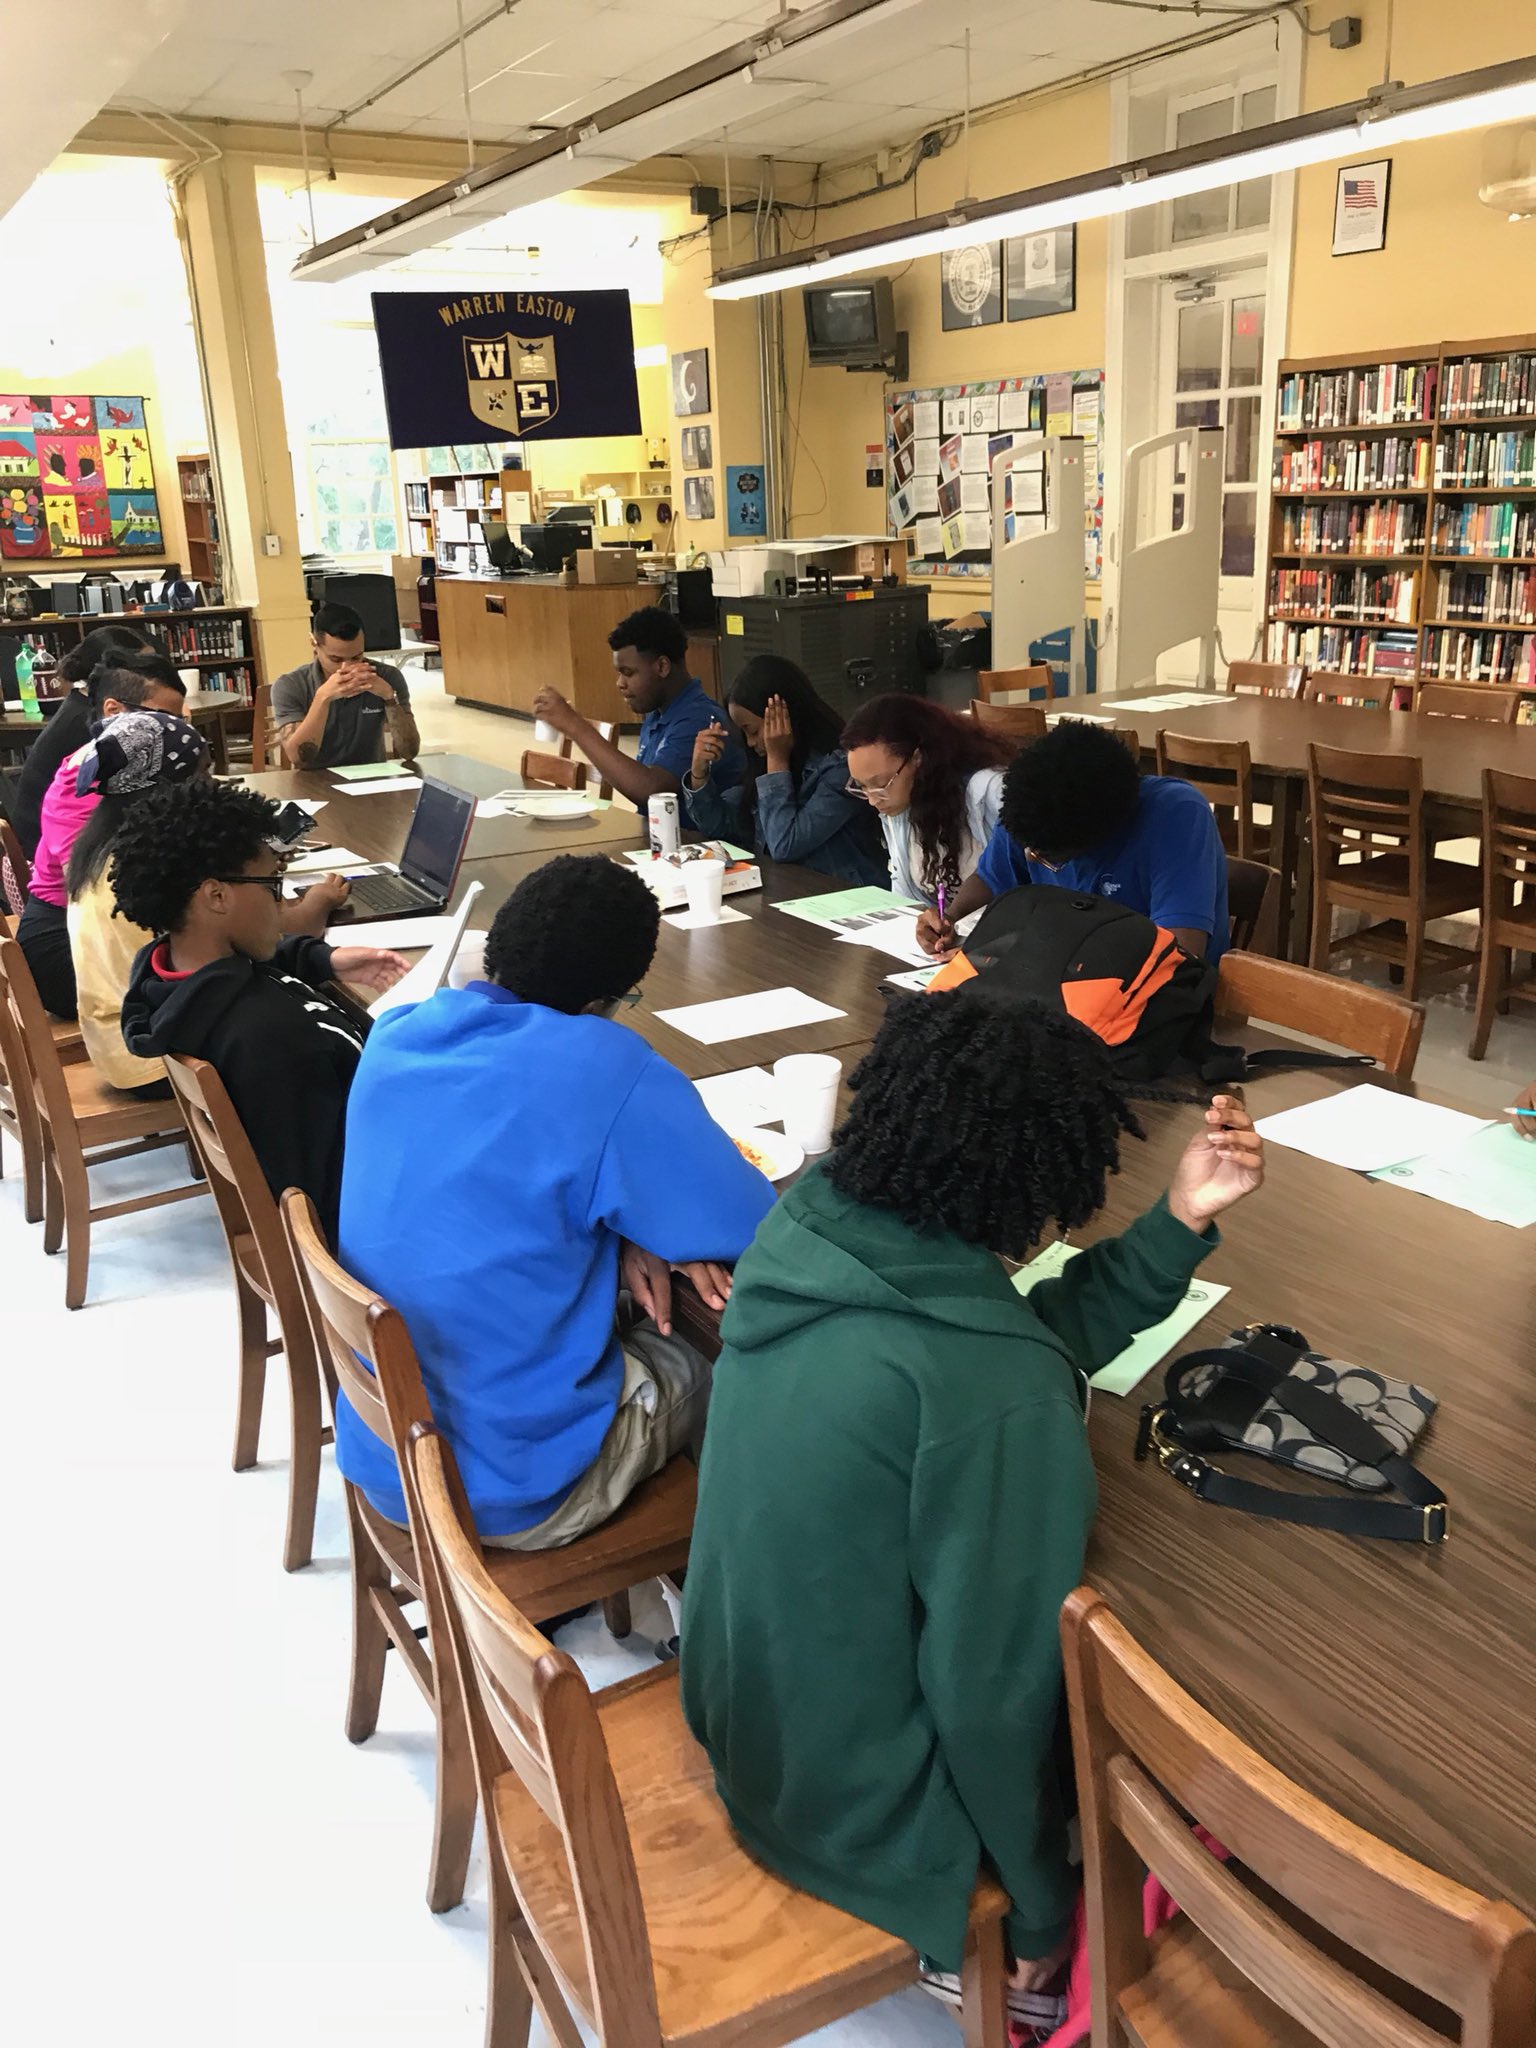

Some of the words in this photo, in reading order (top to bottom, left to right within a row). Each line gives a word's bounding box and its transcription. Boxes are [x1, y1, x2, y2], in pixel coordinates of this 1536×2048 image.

[438, 293, 505, 326] WARREN
[517, 293, 575, 325] EASTON
[470, 343, 506, 378] W
[517, 383, 550, 418] E
